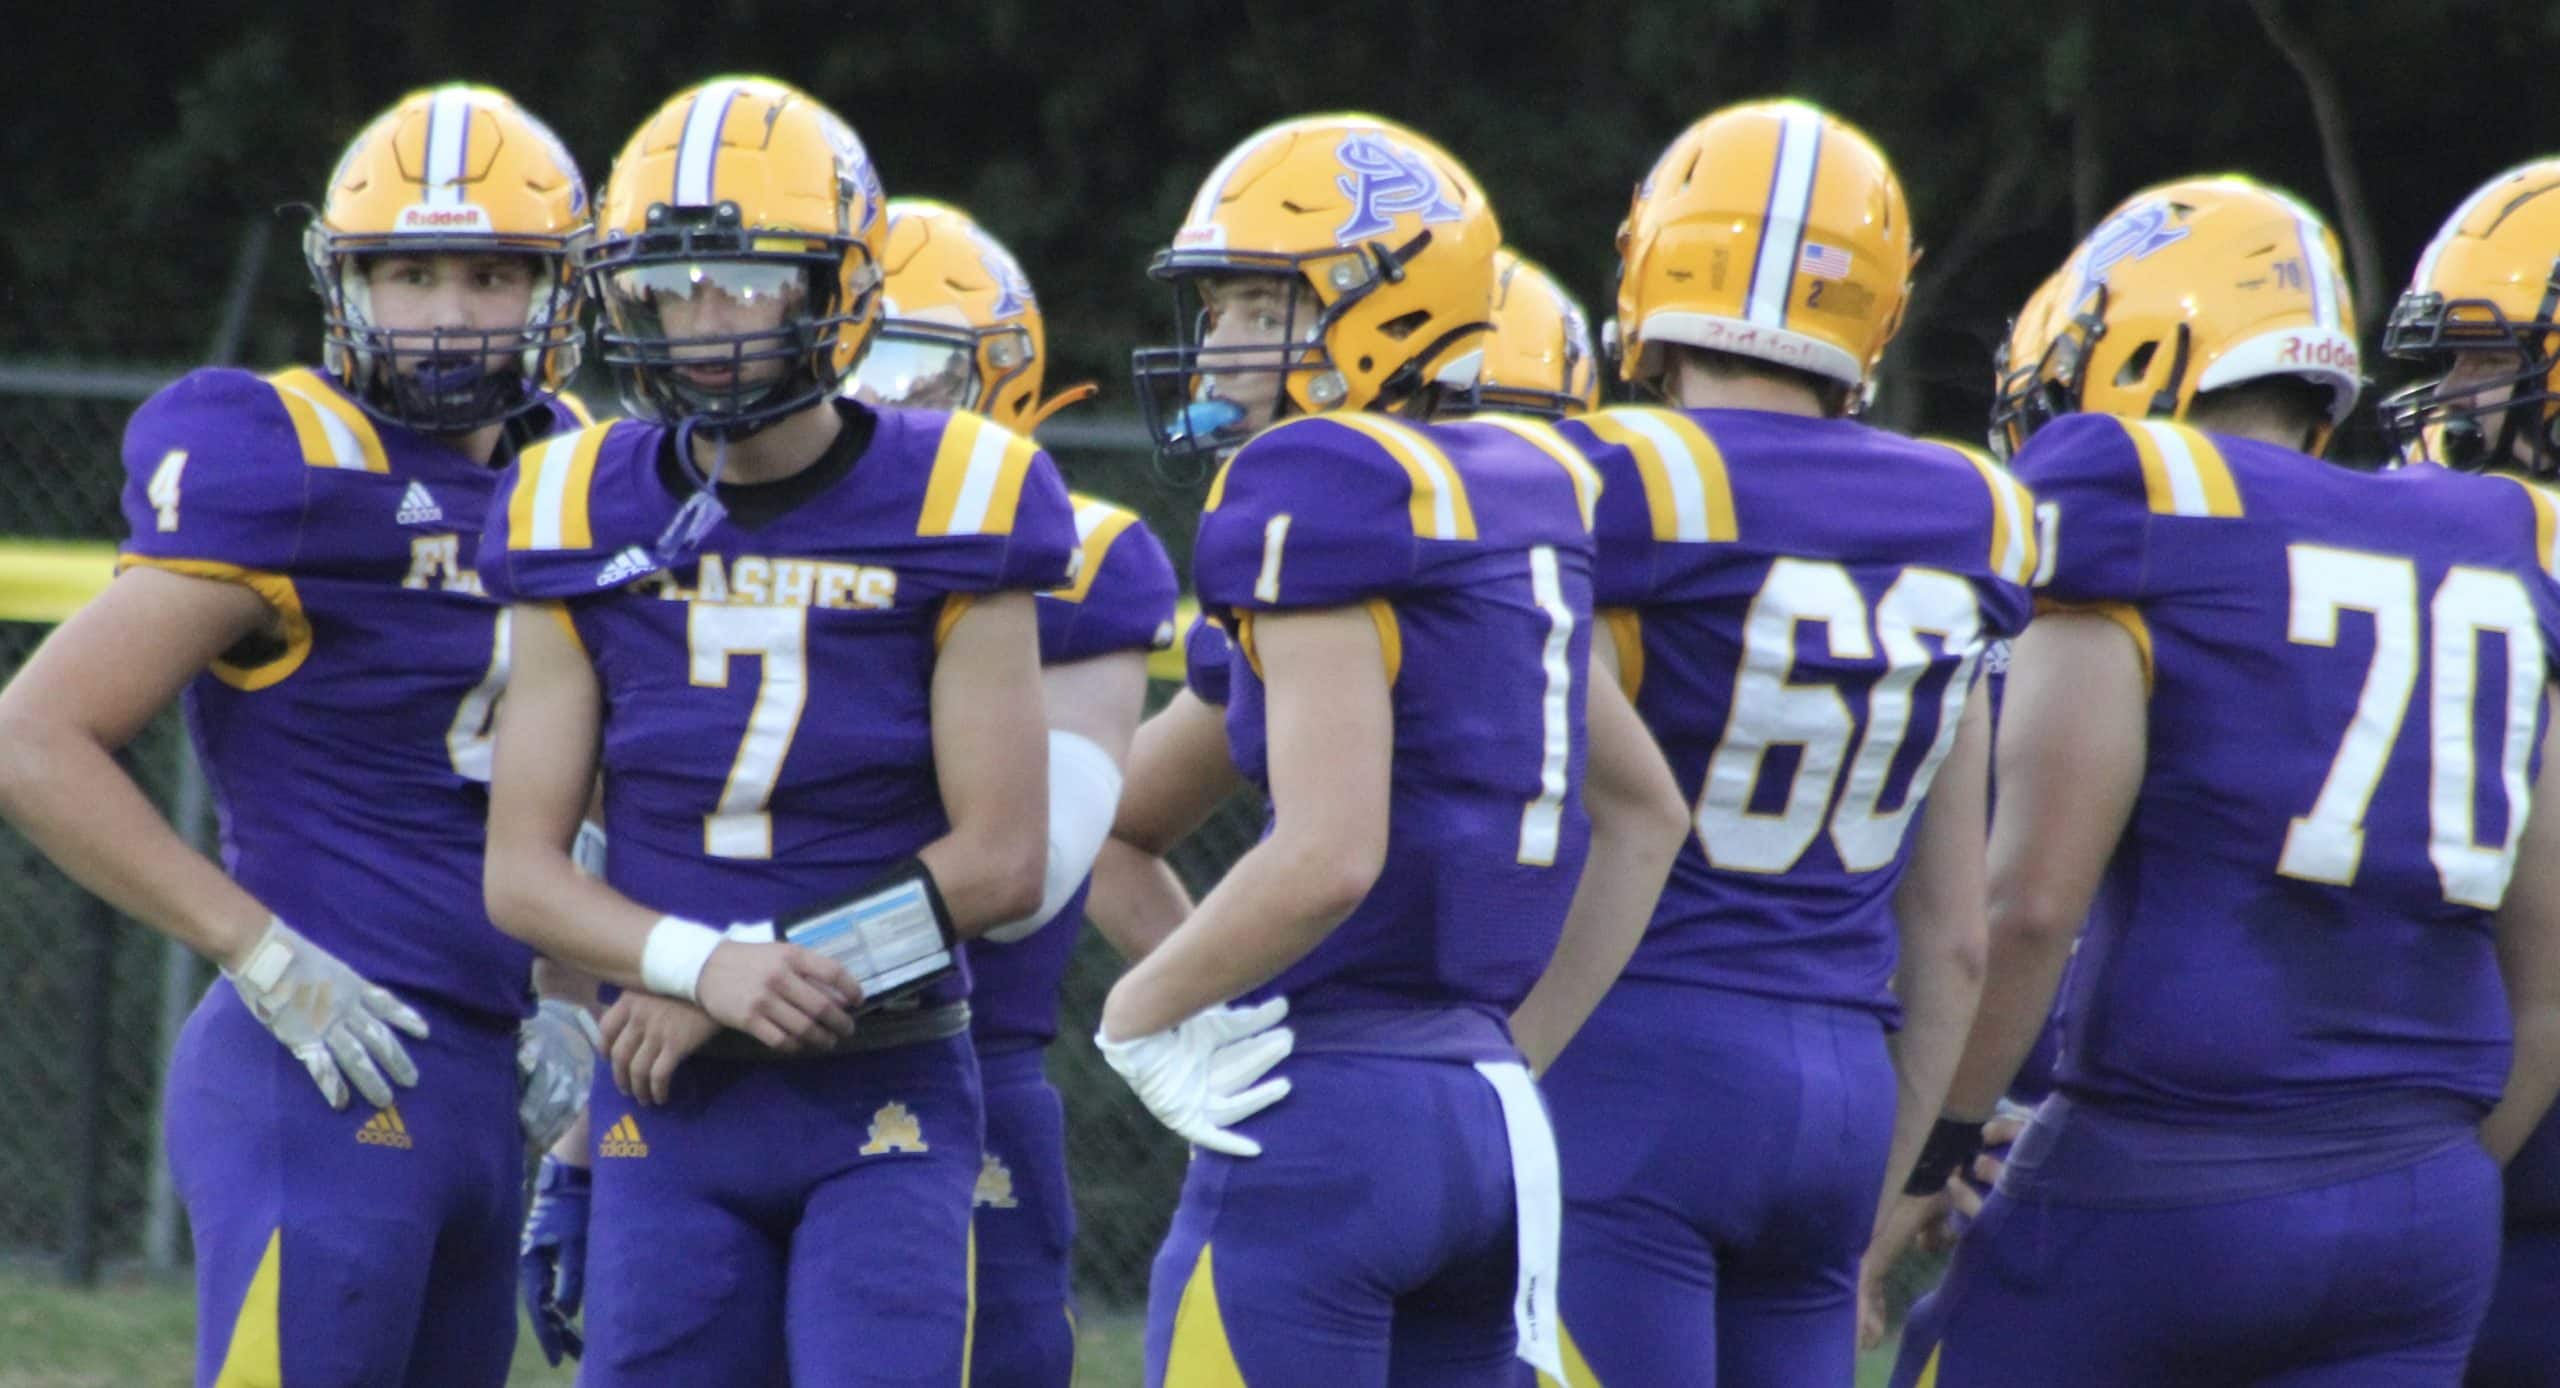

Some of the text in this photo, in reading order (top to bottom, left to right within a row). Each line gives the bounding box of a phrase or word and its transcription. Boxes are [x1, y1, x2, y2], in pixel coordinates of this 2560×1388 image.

[1806, 280, 1824, 309] 2
[147, 449, 189, 532] 4
[1253, 514, 1292, 604] 1
[686, 600, 808, 860] 7
[1517, 546, 1575, 867] 1
[1694, 556, 1980, 874] 60
[2275, 543, 2549, 911] 70
